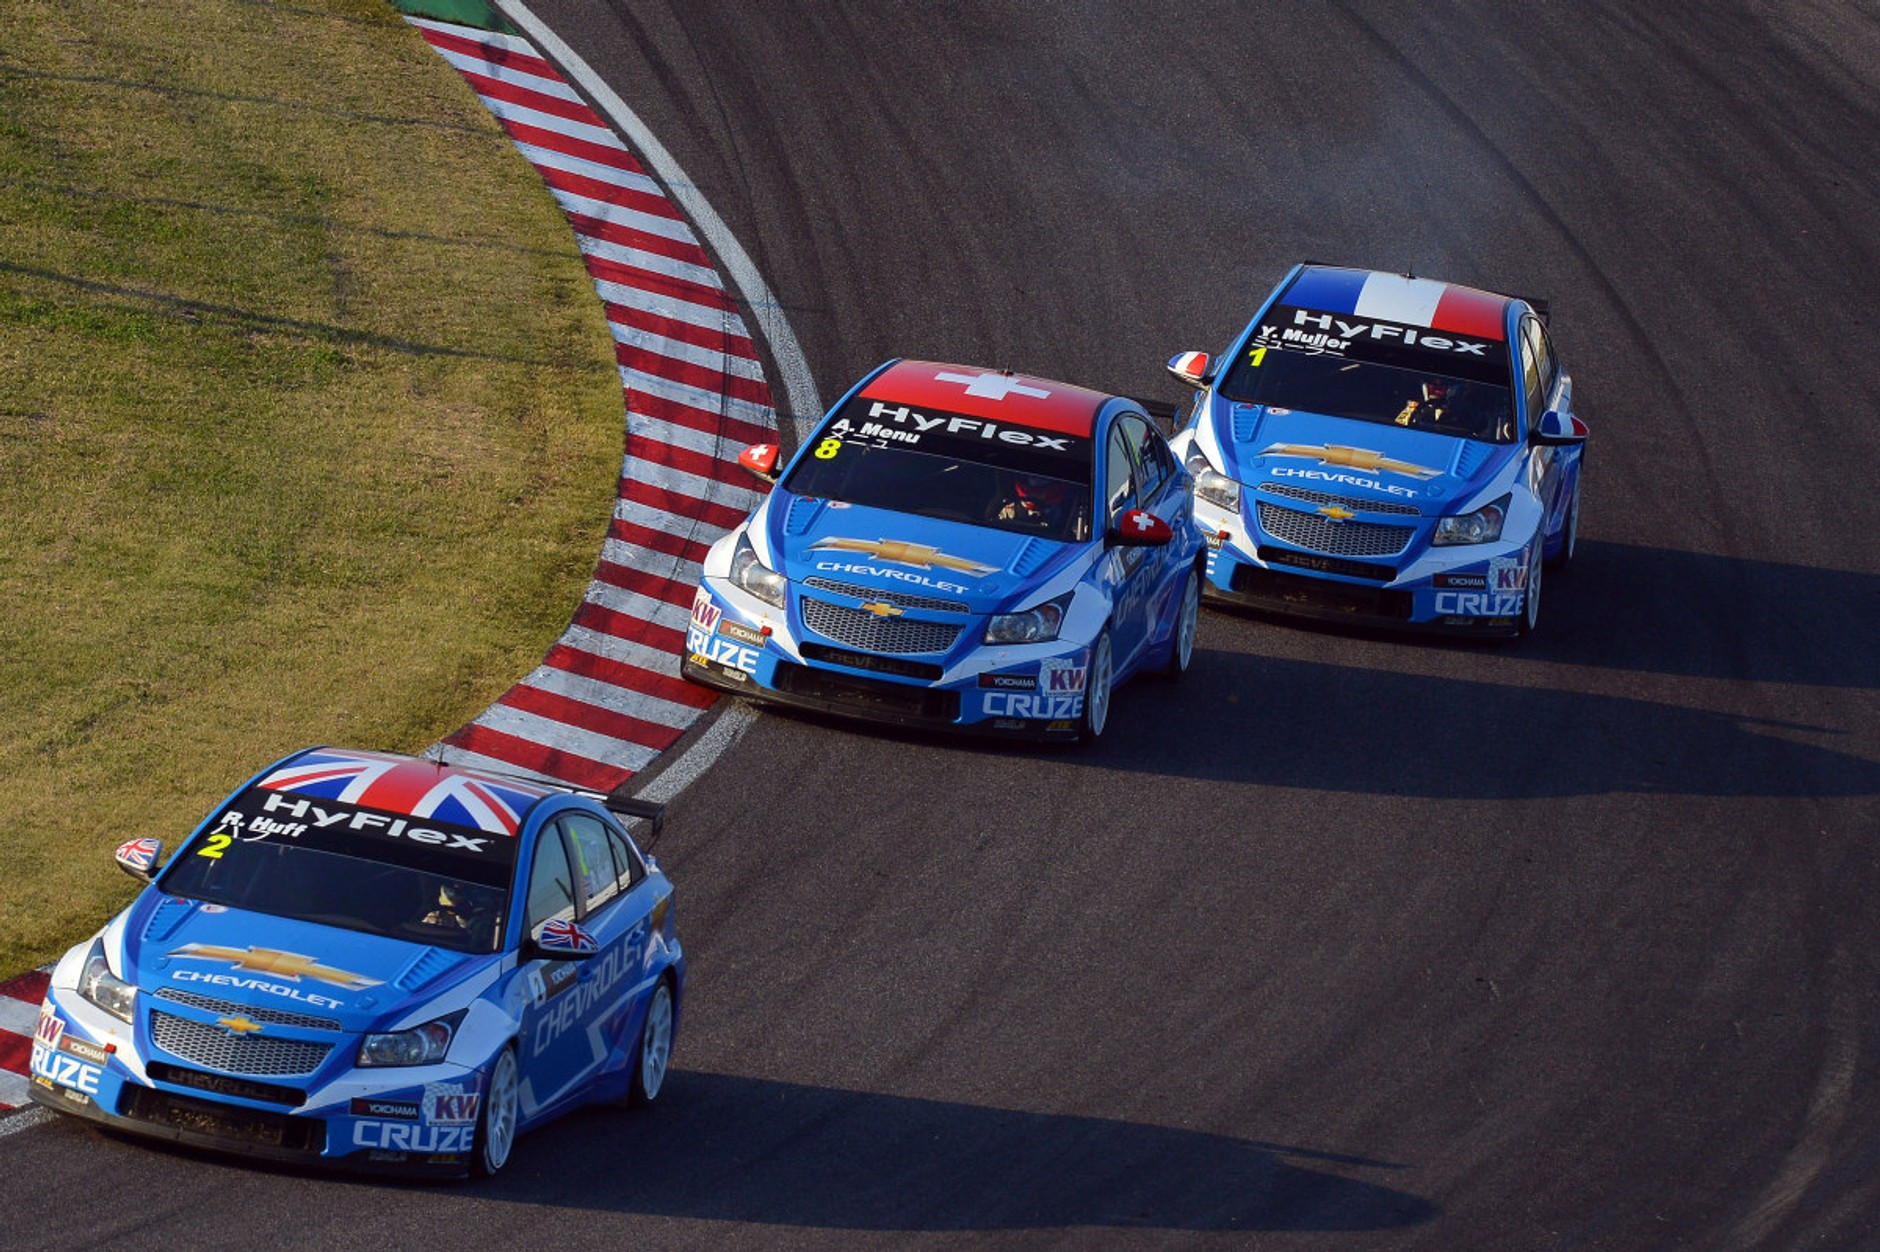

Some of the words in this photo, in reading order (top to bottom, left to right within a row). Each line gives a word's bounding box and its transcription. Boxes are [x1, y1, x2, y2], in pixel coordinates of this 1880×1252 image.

[1260, 325, 1279, 339] Y.
[1282, 328, 1351, 350] Muller
[1294, 309, 1487, 356] HyFlex
[1248, 347, 1268, 367] 1
[831, 418, 855, 432] A.
[860, 422, 921, 444] Menu
[869, 401, 1069, 451] HyFlex
[814, 438, 842, 459] 8
[1270, 466, 1419, 499] CHEVROLET
[815, 561, 970, 595] CHEVROLET
[1435, 591, 1524, 616] CRUZE
[993, 676, 1036, 688] YOKOHAMA
[1049, 668, 1086, 691] KW
[982, 692, 1084, 719] CRUZE
[220, 810, 245, 828] R.
[248, 816, 309, 838] Huff
[263, 792, 489, 853] HyFlex
[197, 833, 232, 859] 2
[171, 969, 345, 1010] CHEVROLET
[30, 1044, 102, 1094] RUZE
[367, 1103, 418, 1117] YOKOHAMA
[434, 1094, 480, 1120] KW
[352, 1119, 476, 1152] CRUZE
